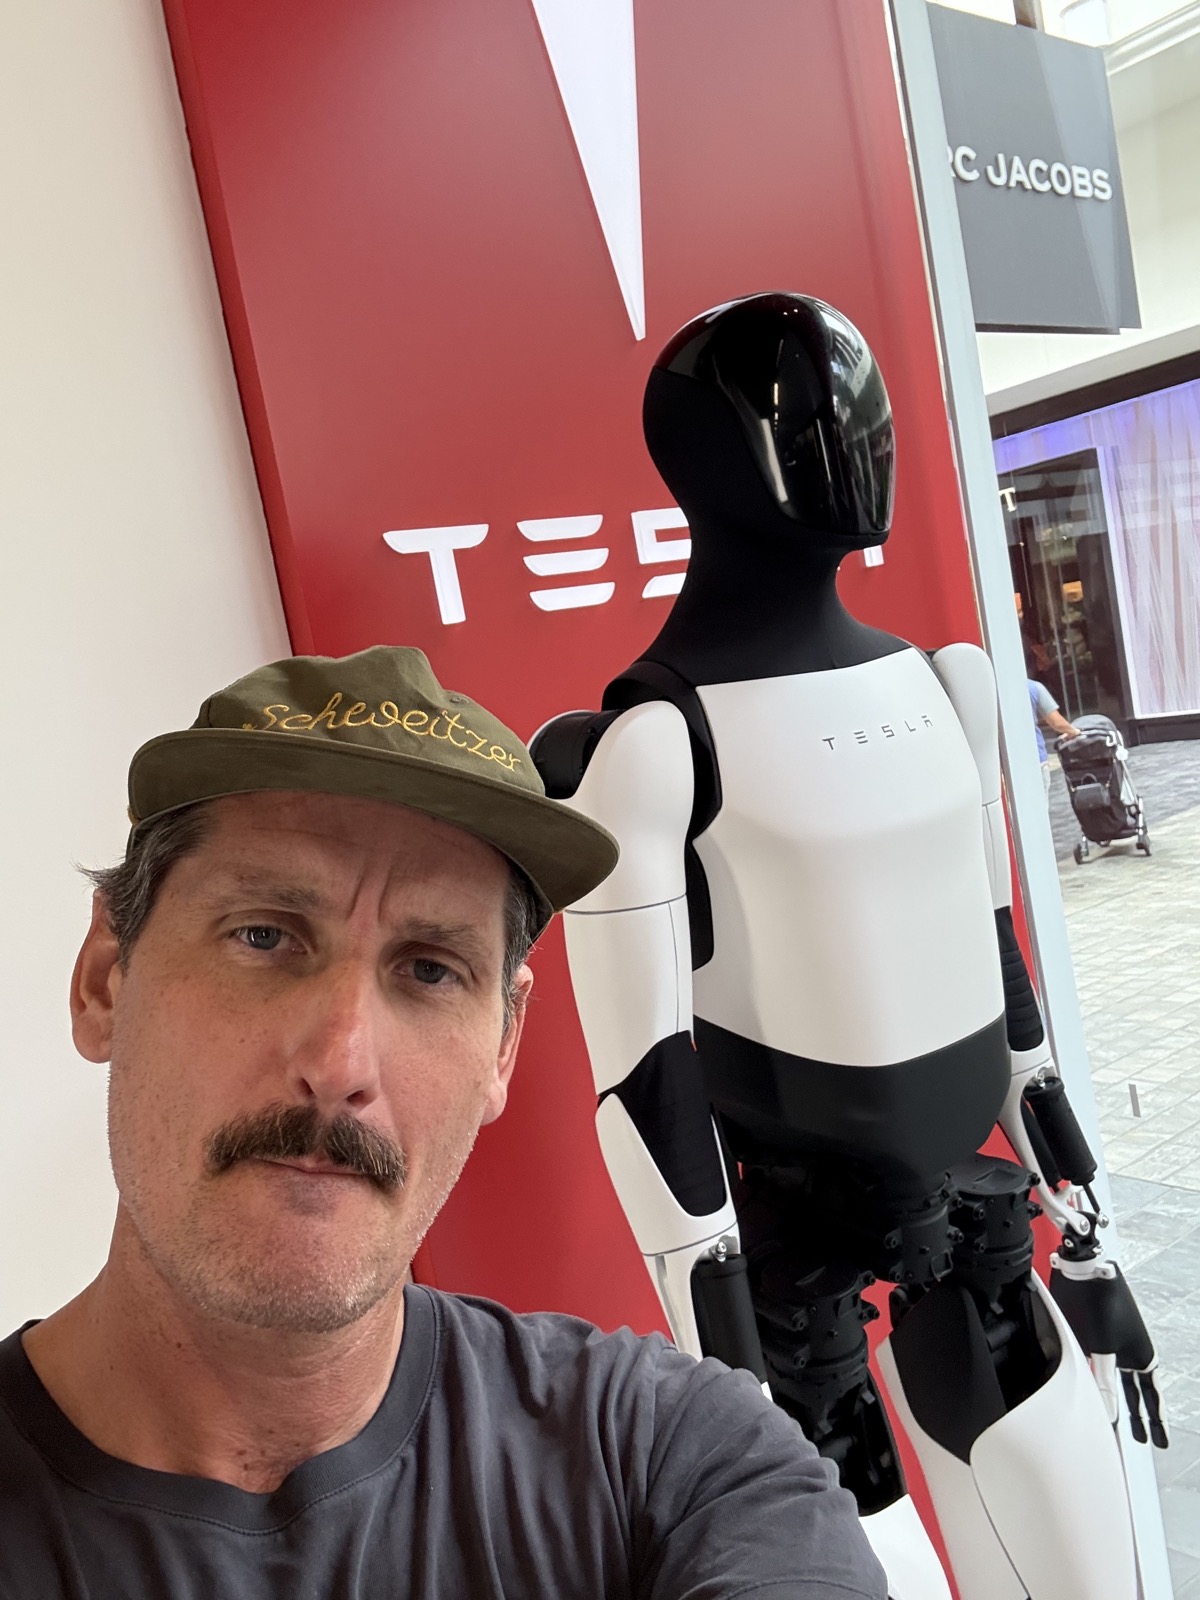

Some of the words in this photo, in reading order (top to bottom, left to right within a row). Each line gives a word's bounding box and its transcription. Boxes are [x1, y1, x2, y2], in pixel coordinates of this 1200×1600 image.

[986, 152, 1112, 201] JACOBS
[382, 507, 884, 625] TES
[822, 715, 933, 750] TESLA
